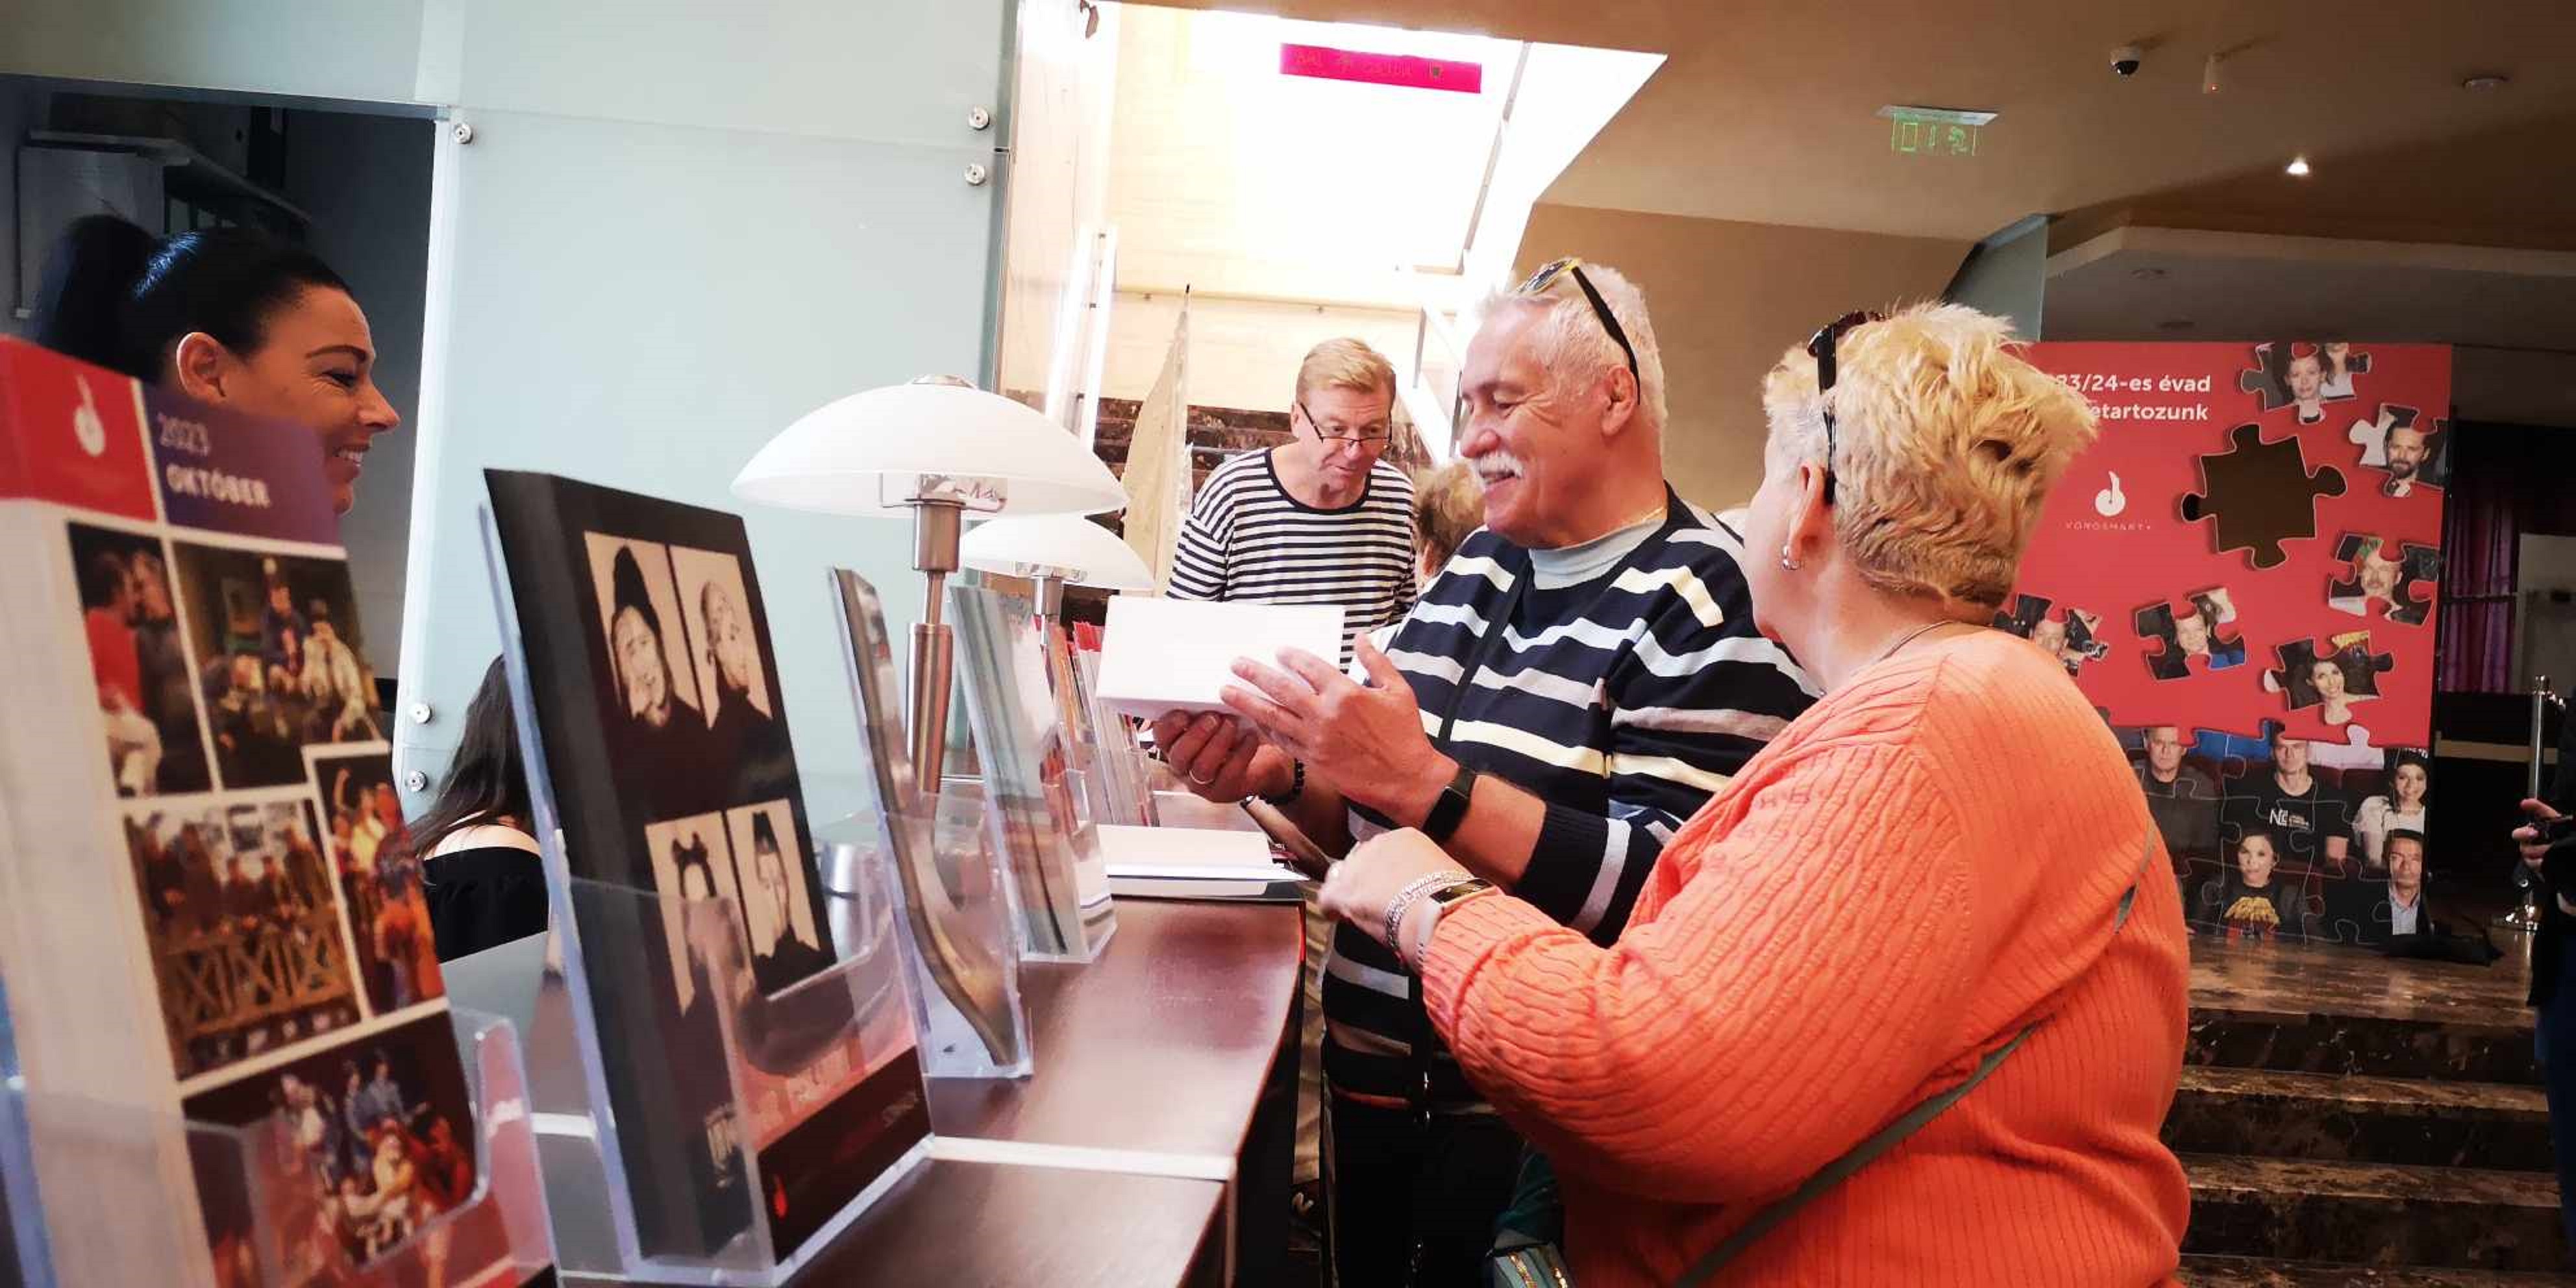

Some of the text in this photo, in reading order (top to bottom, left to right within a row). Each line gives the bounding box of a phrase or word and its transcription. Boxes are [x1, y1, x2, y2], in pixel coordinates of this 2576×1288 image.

[2055, 374, 2211, 392] 23/24-es évad
[2090, 403, 2209, 421] etartozunk
[157, 412, 210, 456] 2023
[166, 463, 271, 508] OKTÓBER
